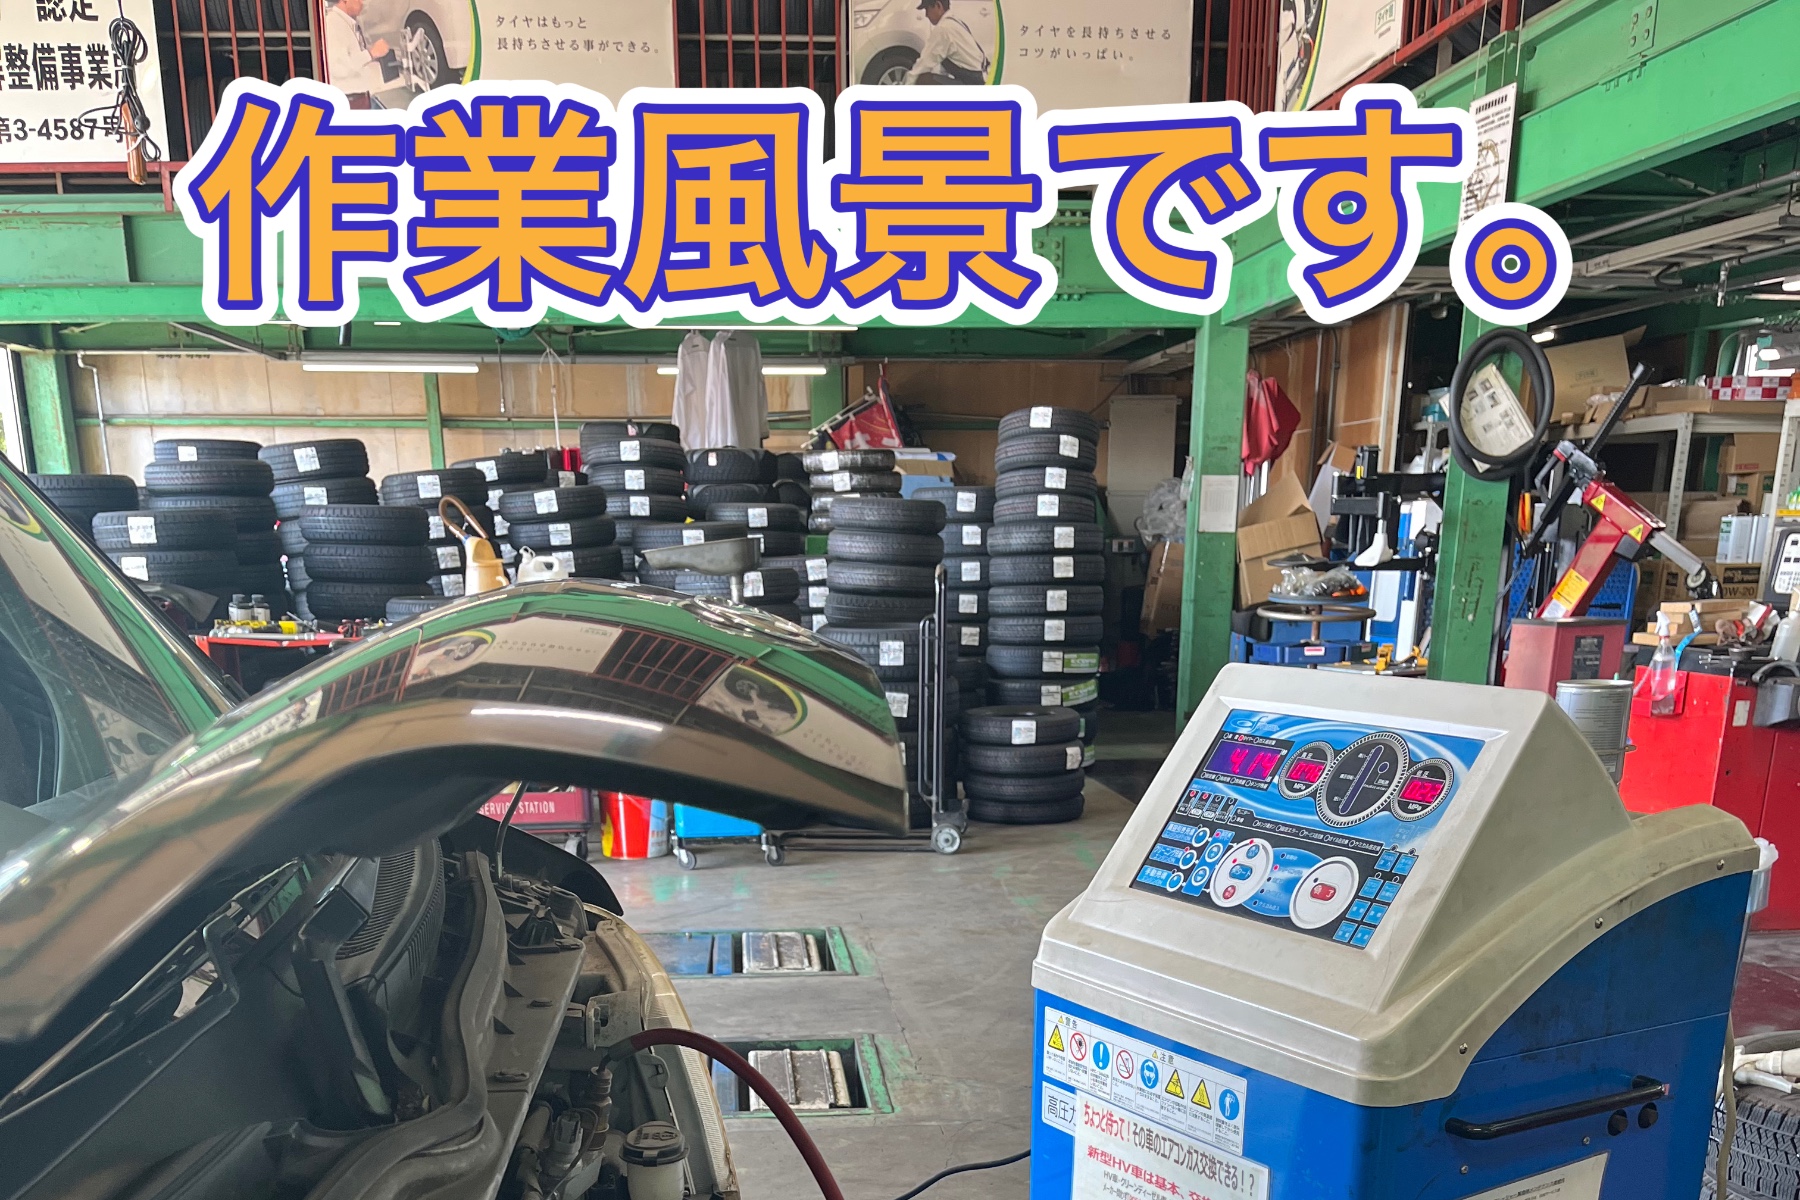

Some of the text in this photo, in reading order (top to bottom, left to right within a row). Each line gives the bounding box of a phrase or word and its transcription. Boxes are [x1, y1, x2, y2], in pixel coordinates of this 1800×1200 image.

[496, 15, 587, 29] タイヤはもっと
[1020, 25, 1171, 40] タイヤを長持ちさせる
[497, 37, 659, 54] 長持ちさせる事ができる。
[1019, 47, 1134, 62] コツがいっぱい。
[0, 42, 138, 91] 整備事業
[479, 801, 555, 815] SERVIC STATION
[1159, 1051, 1175, 1066] 注意
